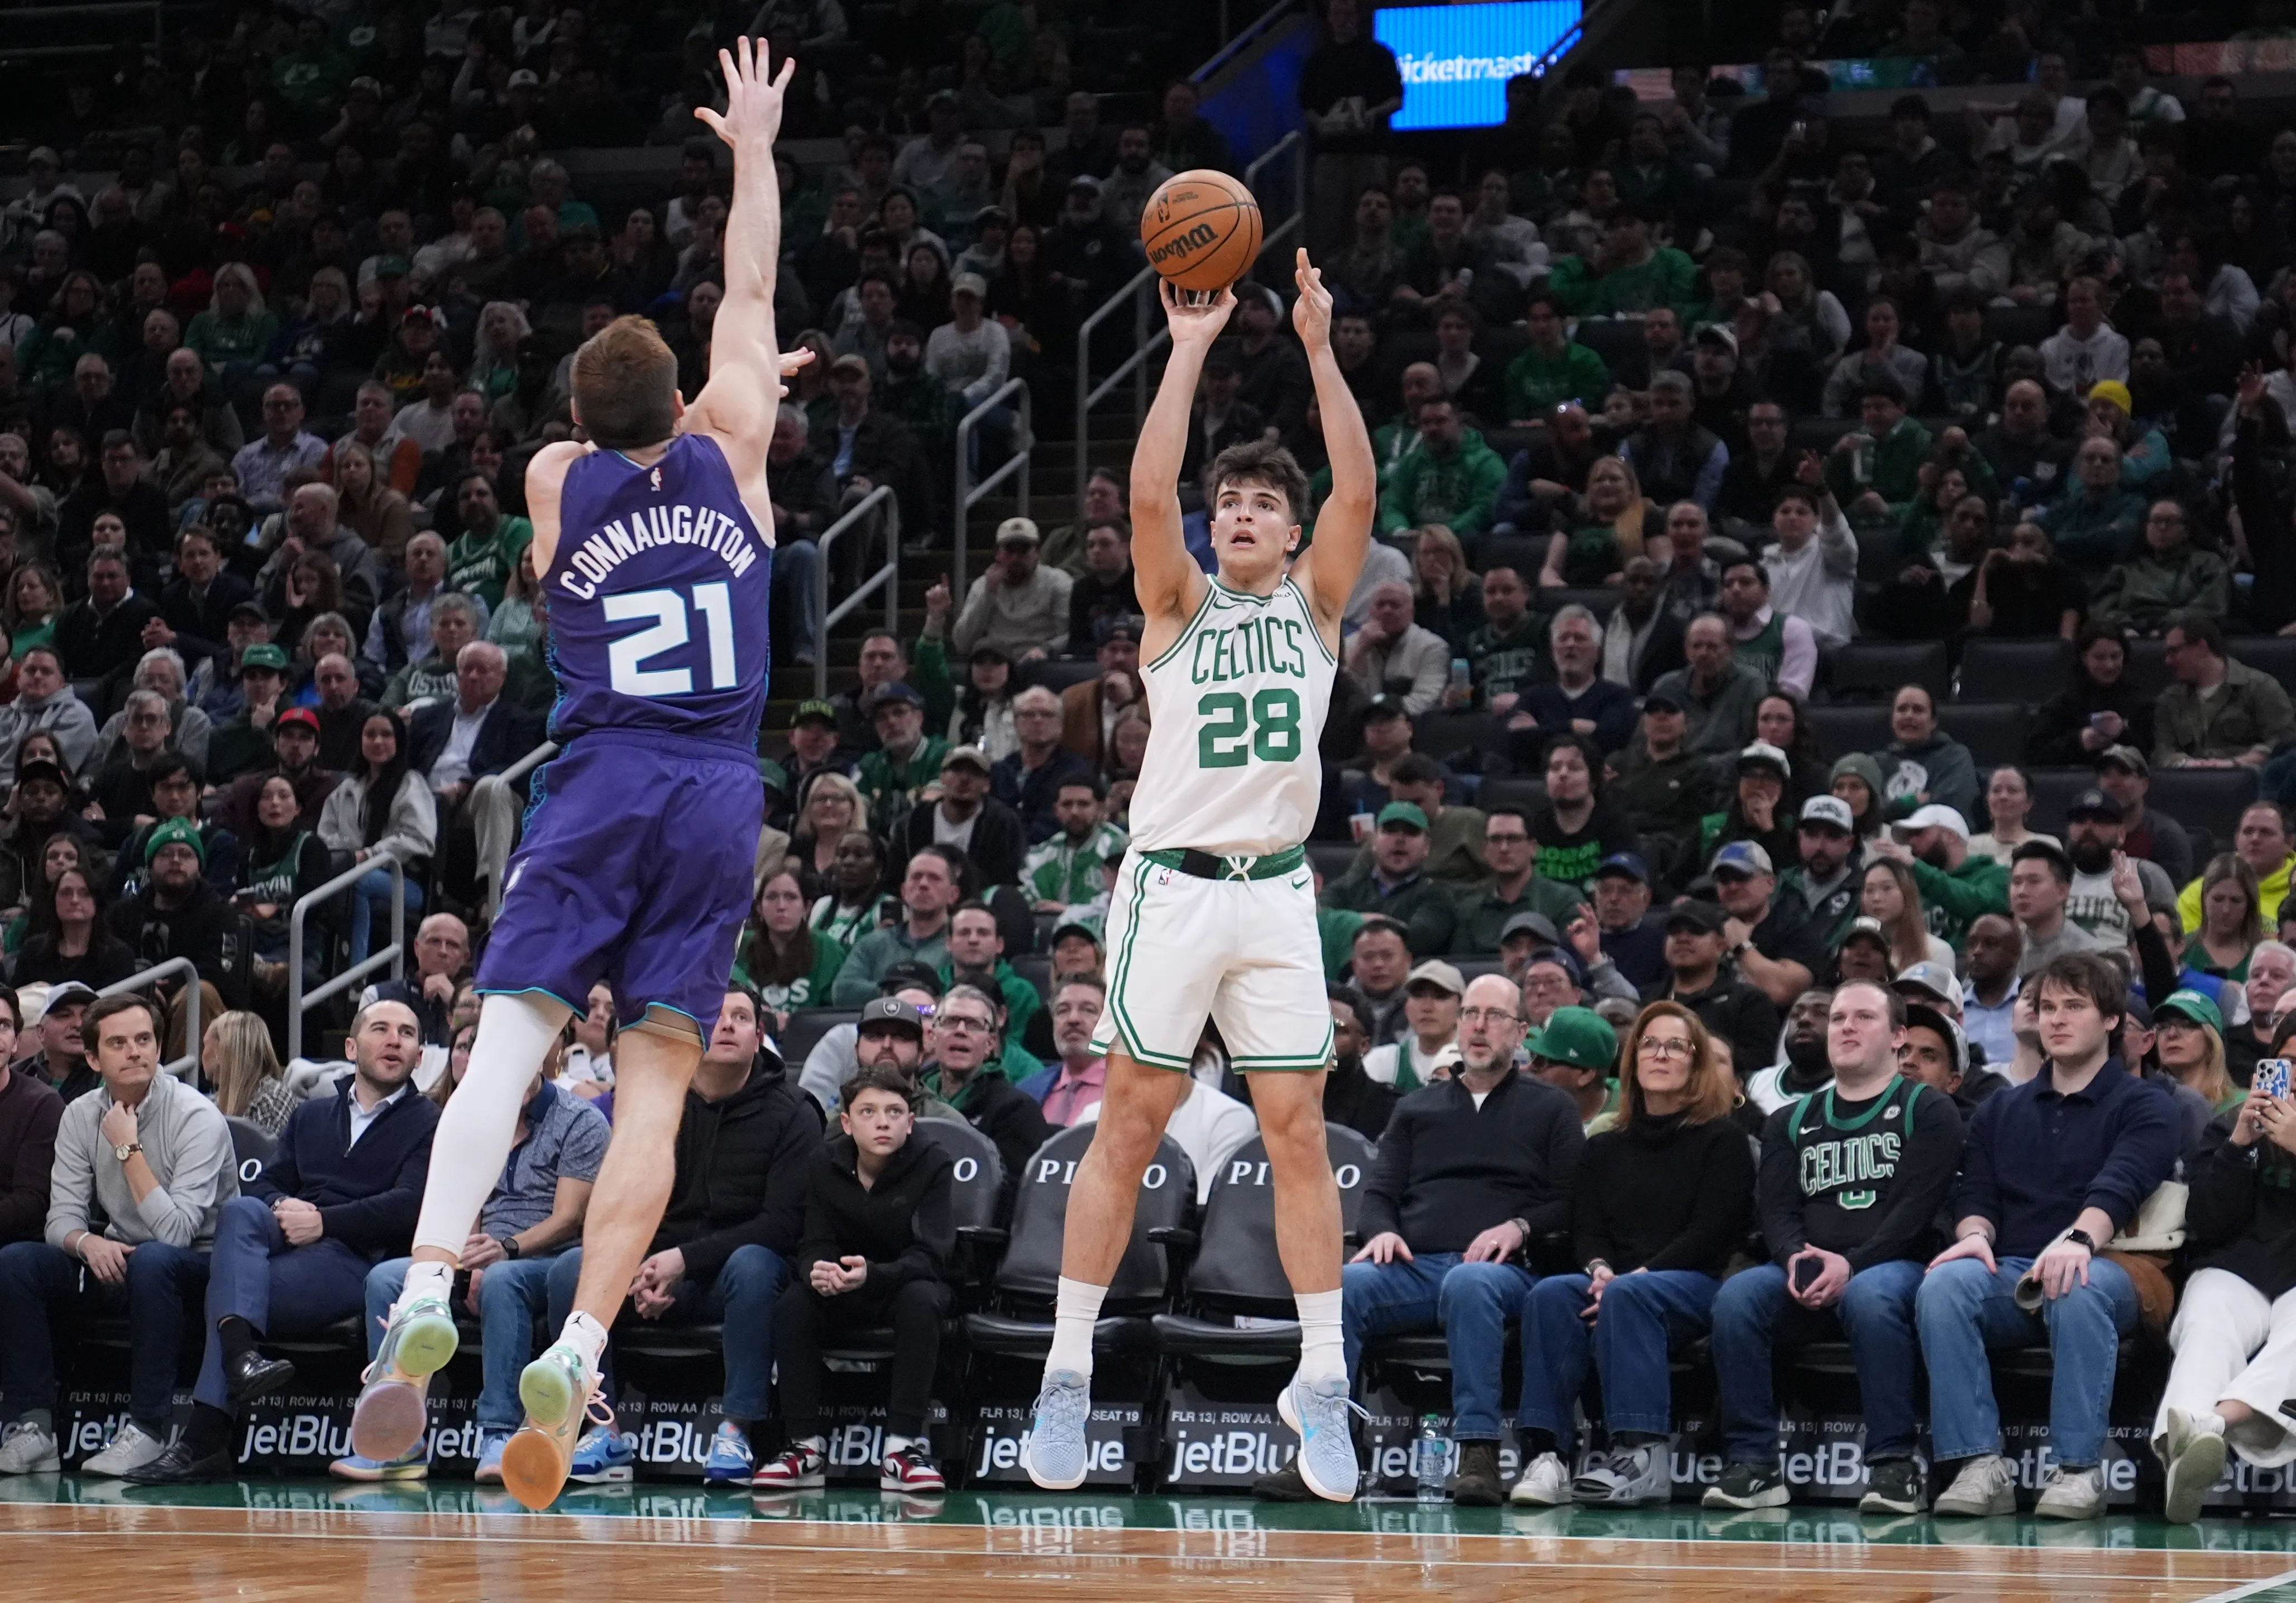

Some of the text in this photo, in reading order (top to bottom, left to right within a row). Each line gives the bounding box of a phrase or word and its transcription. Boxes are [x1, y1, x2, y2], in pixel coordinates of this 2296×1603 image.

[1397, 51, 1557, 83] icketmast
[1149, 223, 1218, 264] Wilson
[559, 505, 756, 600] CONNAUGHTON
[601, 580, 738, 697] 21
[1192, 616, 1306, 685] CELTICS
[1198, 688, 1302, 769] 28
[2065, 895, 2125, 928] ELTICS
[1800, 1131, 1901, 1197] CELTICS
[69, 1392, 90, 1403] FLR
[114, 1393, 131, 1404] RO
[172, 1394, 194, 1405] SEA
[289, 1396, 317, 1407] ROW
[318, 1396, 334, 1408] AA
[426, 1397, 448, 1409] FLR
[650, 1401, 680, 1413] ROW
[681, 1402, 697, 1414] AA
[980, 1406, 1003, 1419] FLR
[1091, 1409, 1123, 1421] SEAT
[1125, 1410, 1140, 1422] 19
[1171, 1410, 1195, 1423] FLR
[1221, 1411, 1252, 1424] ROW
[1253, 1413, 1272, 1424] AA
[1368, 1416, 1392, 1427] FLR
[1419, 1416, 1451, 1428] RW
[1778, 1420, 1796, 1433] LR
[1824, 1421, 1855, 1433] ROW
[2030, 1426, 2050, 1438] RO
[2107, 1427, 2132, 1439] EAT
[238, 1413, 352, 1463] jetBlu
[620, 1420, 718, 1463] etBlu
[975, 1425, 1125, 1478] jete
[1168, 1430, 1295, 1482] jetBlu
